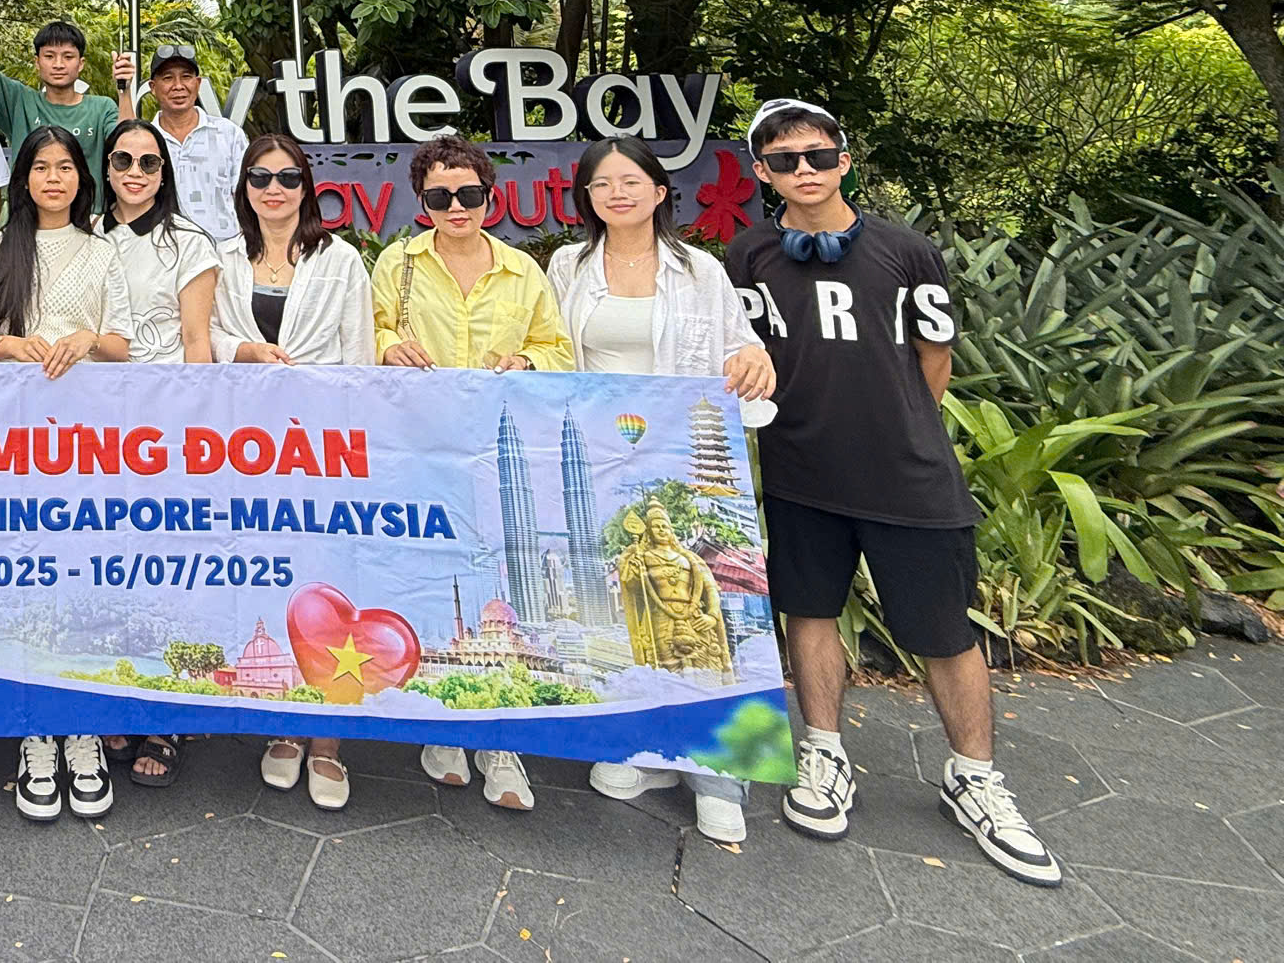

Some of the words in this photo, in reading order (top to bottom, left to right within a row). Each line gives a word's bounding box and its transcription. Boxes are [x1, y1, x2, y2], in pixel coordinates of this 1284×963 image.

[275, 49, 462, 142] the
[469, 48, 719, 171] Bay
[316, 181, 394, 234] ay
[414, 162, 584, 227] out
[734, 280, 955, 344] PARIS
[182, 417, 370, 478] ĐOÀN
[90, 553, 294, 590] 16/07/2025
